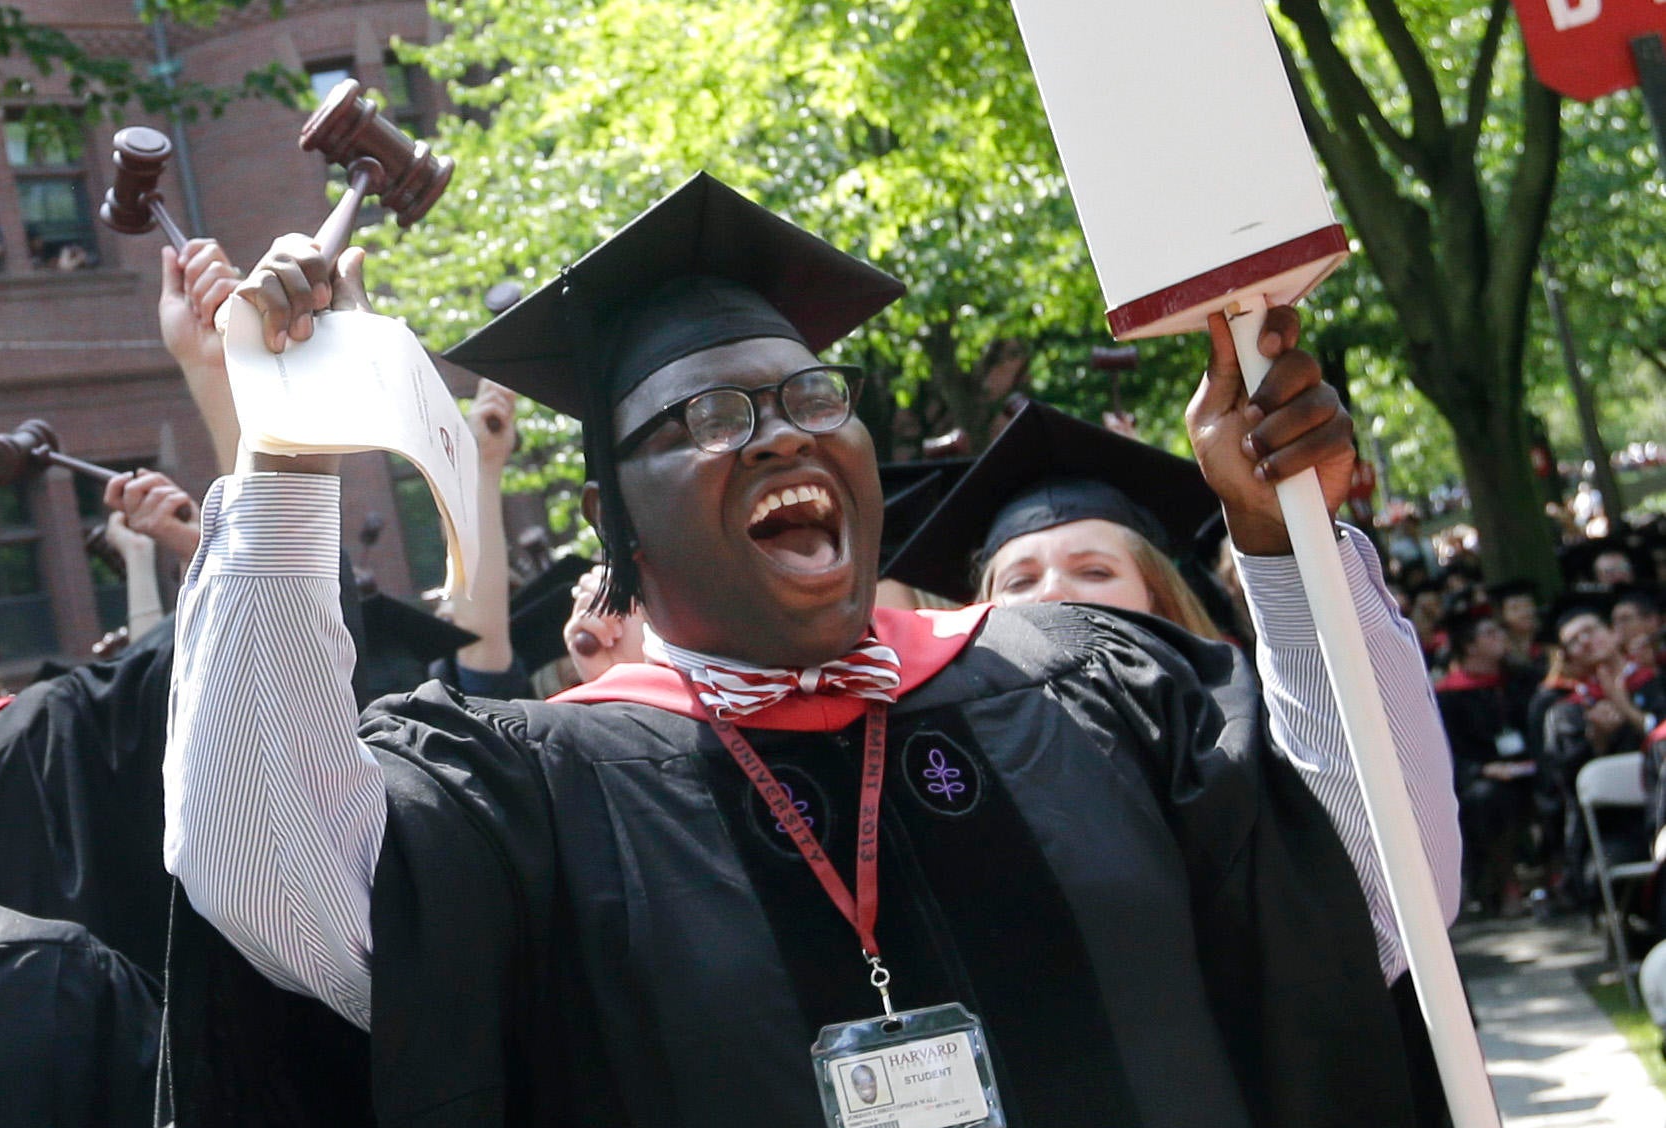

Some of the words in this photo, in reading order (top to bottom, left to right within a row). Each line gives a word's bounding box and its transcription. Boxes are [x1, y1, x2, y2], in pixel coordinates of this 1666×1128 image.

[732, 739, 824, 863] UNIVERSITY
[860, 805, 876, 863] 2013
[888, 1041, 958, 1068] HARVARD
[903, 1066, 952, 1085] STUDENT
